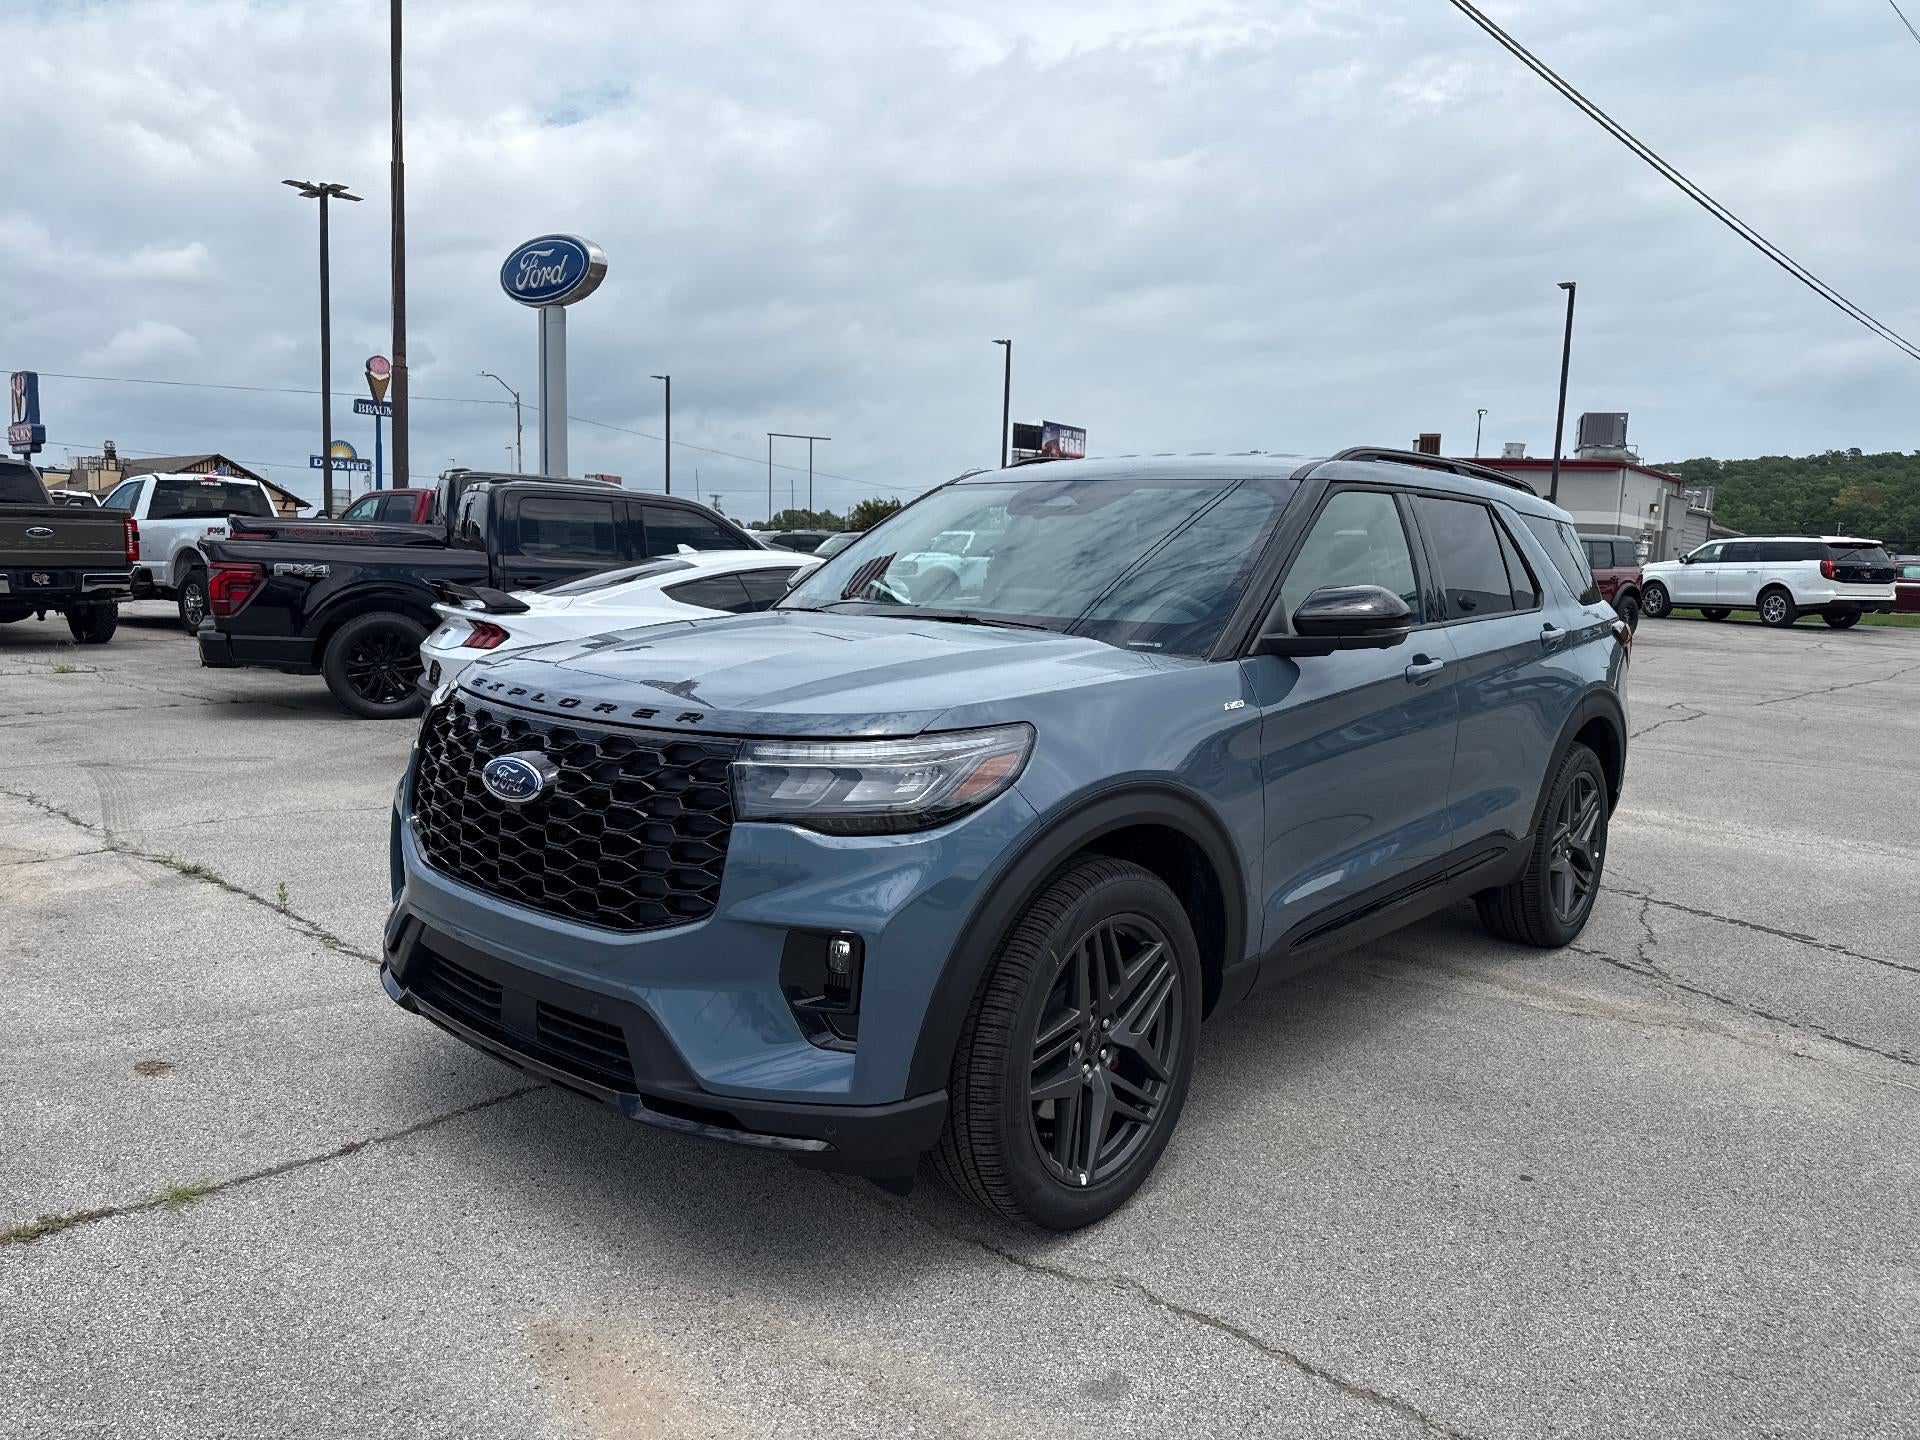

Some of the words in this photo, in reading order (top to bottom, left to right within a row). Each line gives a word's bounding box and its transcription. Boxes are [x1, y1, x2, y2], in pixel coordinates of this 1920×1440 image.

[515, 248, 568, 291] Ford
[314, 459, 345, 469] Dys
[346, 460, 368, 470] Inn
[274, 563, 330, 577] FX4
[470, 677, 705, 723] EXPLORER
[492, 765, 526, 792] Ford
